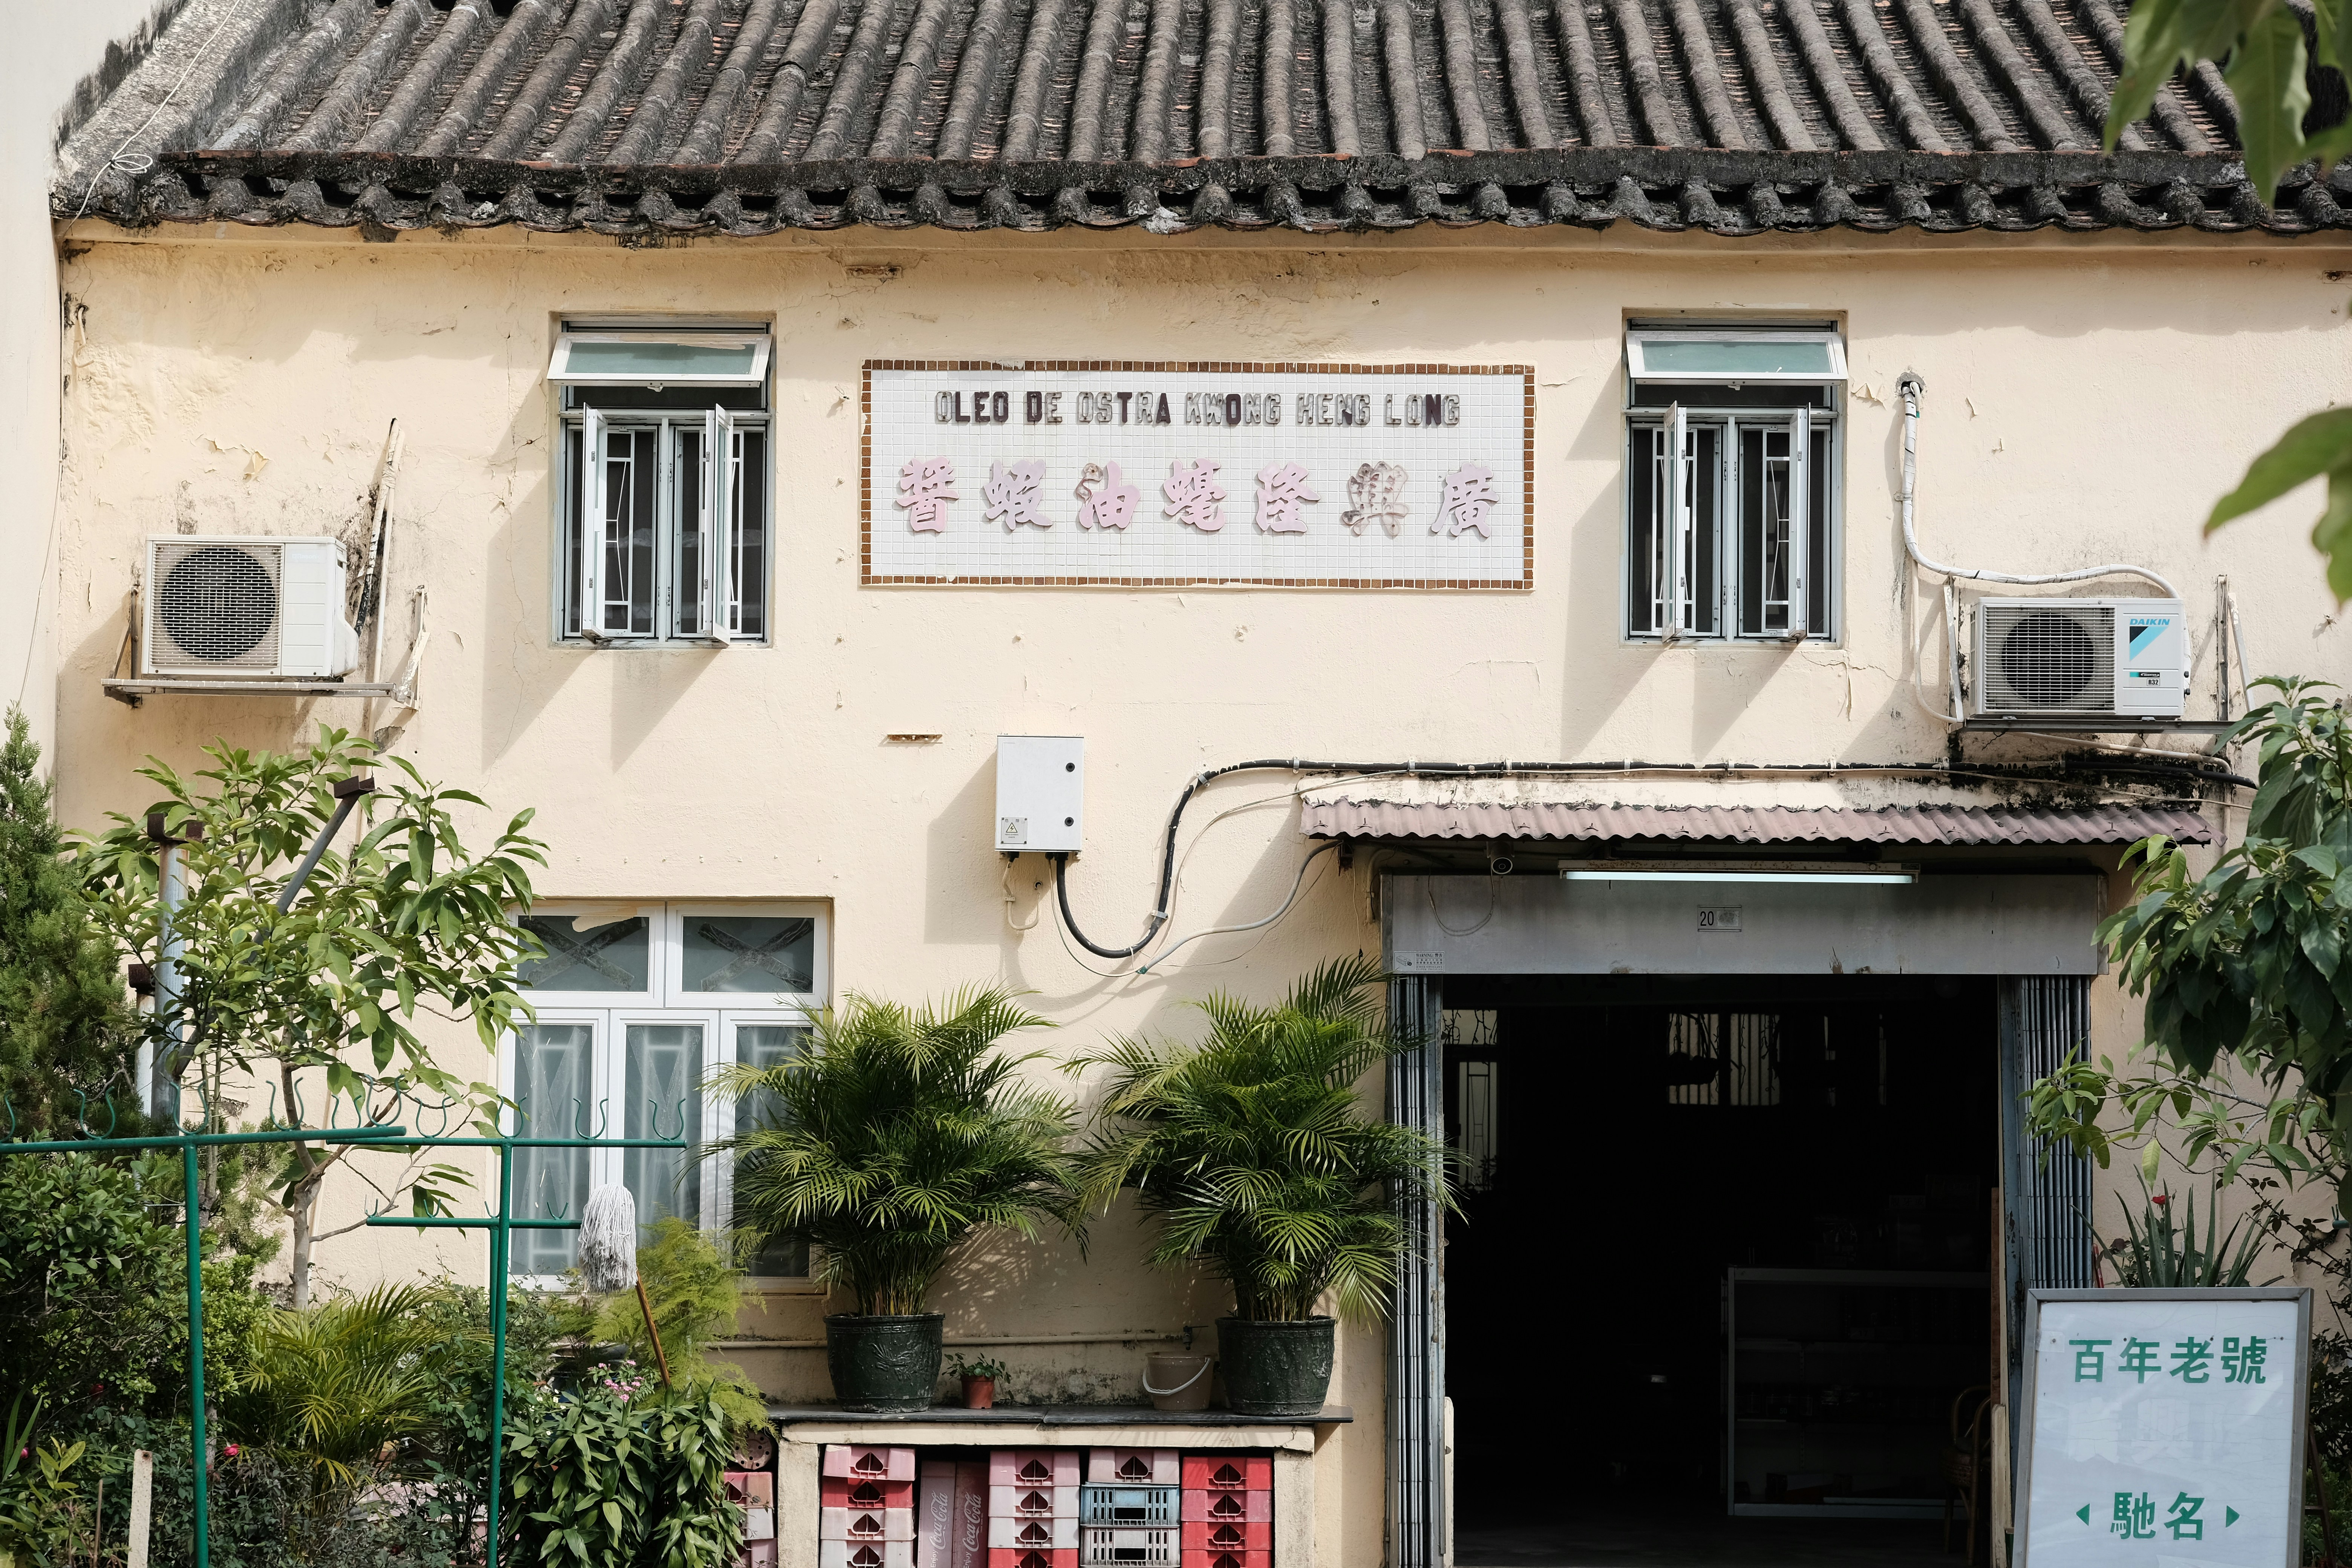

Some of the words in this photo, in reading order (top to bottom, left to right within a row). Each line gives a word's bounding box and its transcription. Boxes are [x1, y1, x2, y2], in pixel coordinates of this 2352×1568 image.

[937, 391, 1009, 422] OLEO
[1026, 391, 1063, 422] DE
[1078, 392, 1171, 424] OSTRA
[1186, 392, 1281, 424] KWONG
[1297, 393, 1370, 424] HENG
[1385, 394, 1459, 425] LONG
[1700, 911, 1714, 926] 20
[2069, 1336, 2268, 1384] 百年老號
[929, 1490, 948, 1550] Coca-Cola
[962, 1491, 982, 1552] Coca-Cola
[2110, 1491, 2205, 1540] 馳名
[930, 1550, 939, 1568] Enjoy
